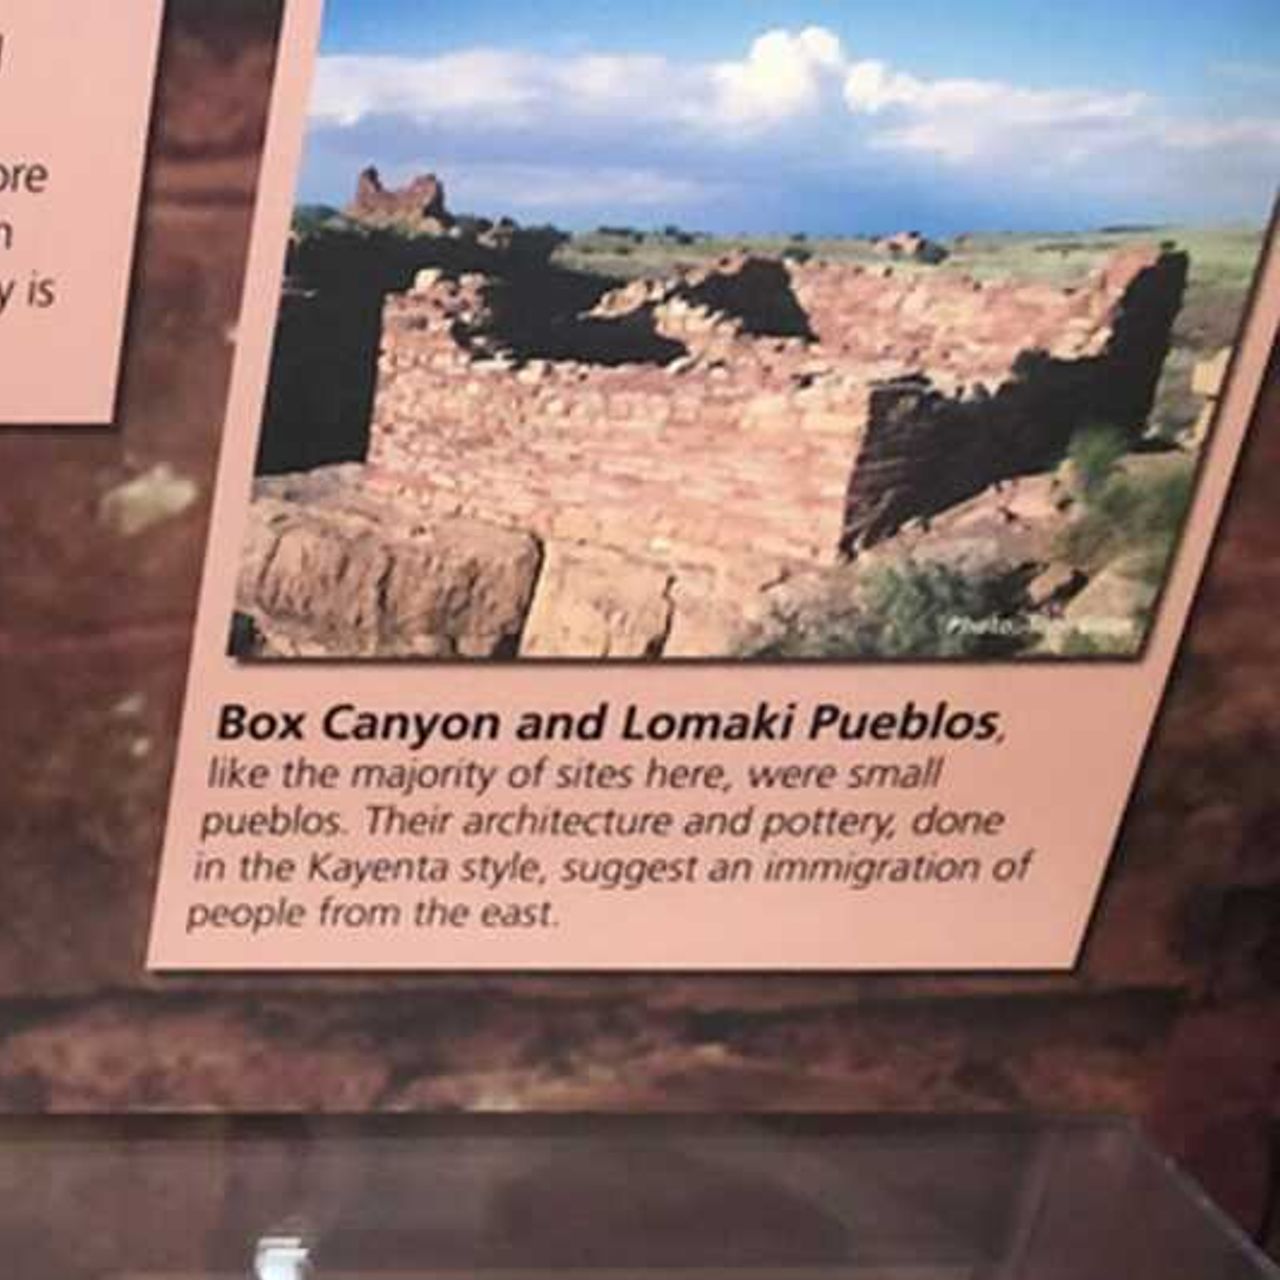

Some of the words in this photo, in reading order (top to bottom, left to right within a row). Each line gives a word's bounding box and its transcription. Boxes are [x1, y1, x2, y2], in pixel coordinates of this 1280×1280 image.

[28, 279, 54, 307] is
[218, 705, 304, 740] Box
[323, 704, 500, 750] Canyon
[516, 703, 608, 740] and
[622, 702, 796, 740] Lomaki
[809, 702, 1003, 742] Pueblos,
[208, 757, 269, 788] like
[283, 757, 339, 788] the
[352, 762, 496, 796] majority
[508, 756, 548, 788] of
[557, 762, 632, 788] sites
[646, 758, 731, 792] here,
[749, 765, 837, 788] were
[848, 756, 944, 788] small
[201, 804, 349, 842] pueblos.
[366, 805, 453, 835] Their
[463, 805, 673, 836] architecture
[684, 806, 754, 836] and
[761, 809, 894, 844] pottery,
[912, 805, 1005, 835] done
[186, 897, 306, 933] people
[320, 896, 400, 927] from
[415, 898, 469, 927] the
[481, 902, 560, 927] east.
